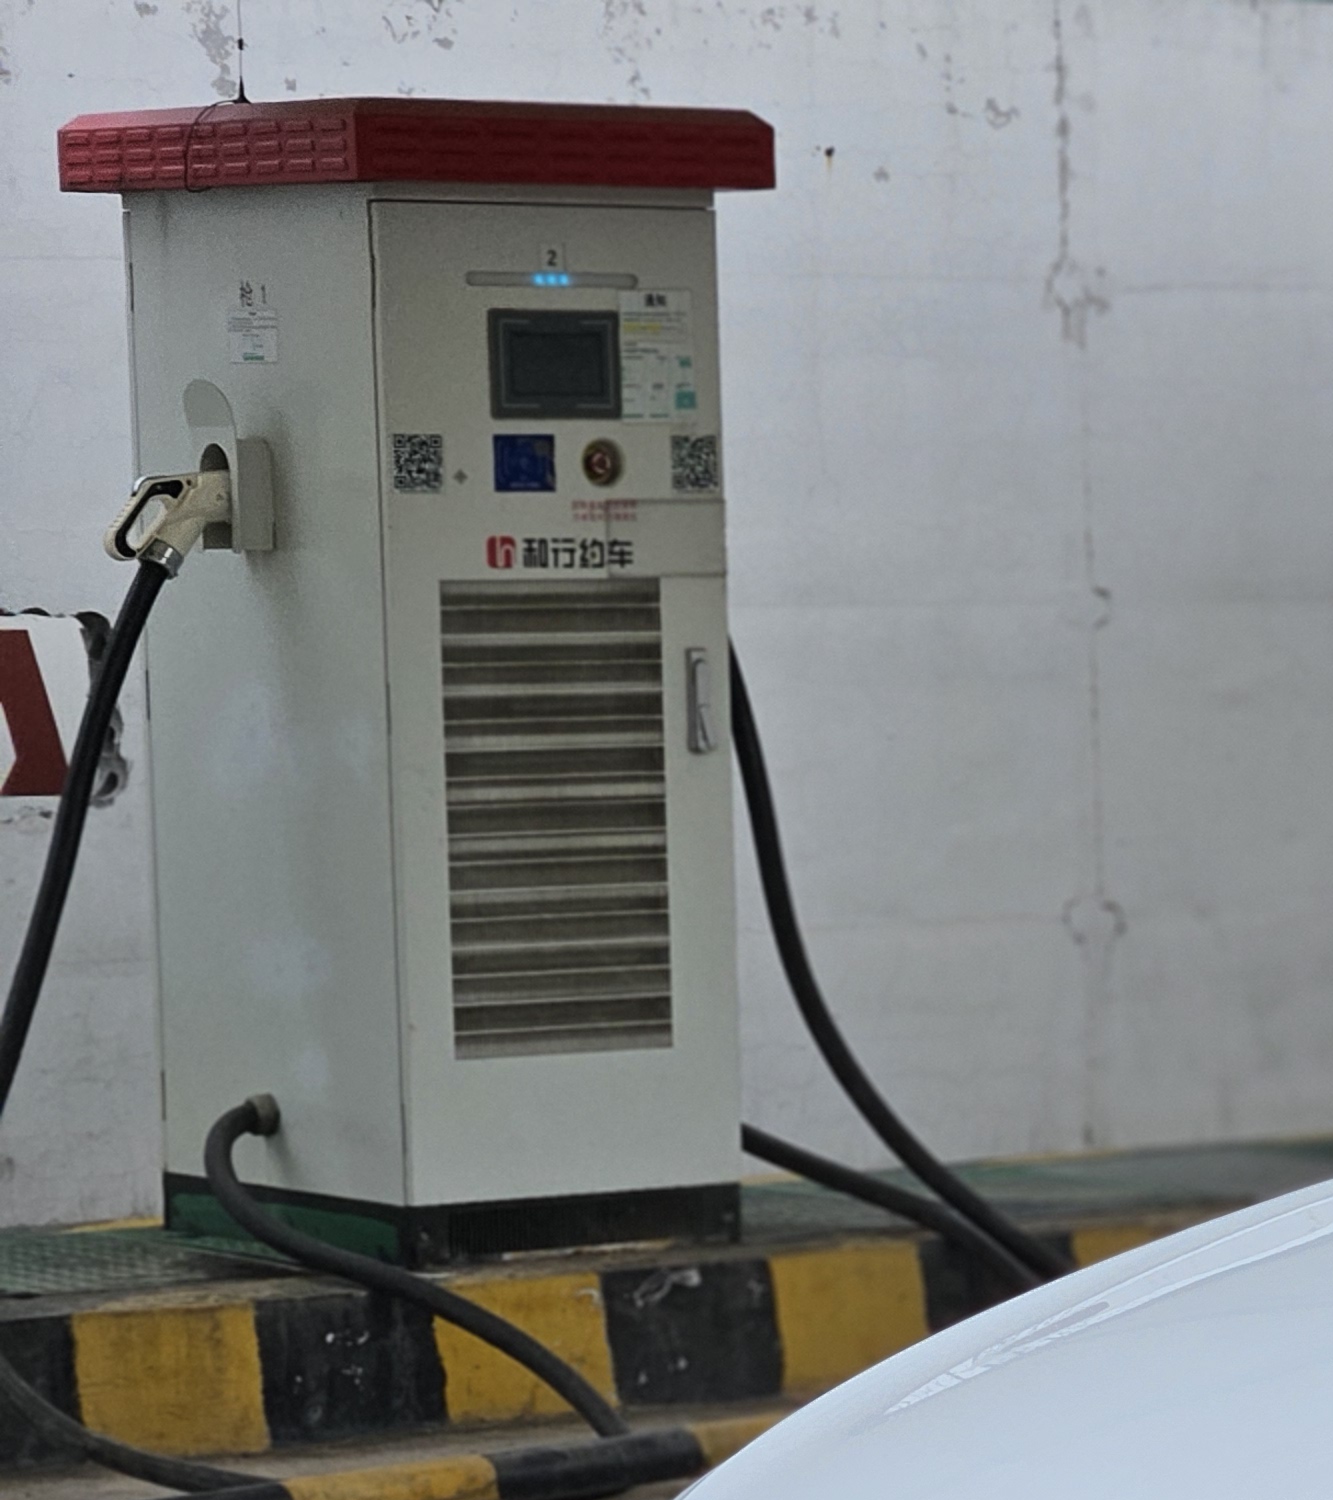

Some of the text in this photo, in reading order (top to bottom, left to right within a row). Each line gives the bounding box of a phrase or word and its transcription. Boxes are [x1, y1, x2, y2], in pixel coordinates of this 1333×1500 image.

[546, 249, 558, 267] 2
[522, 537, 634, 569] 和行约车
